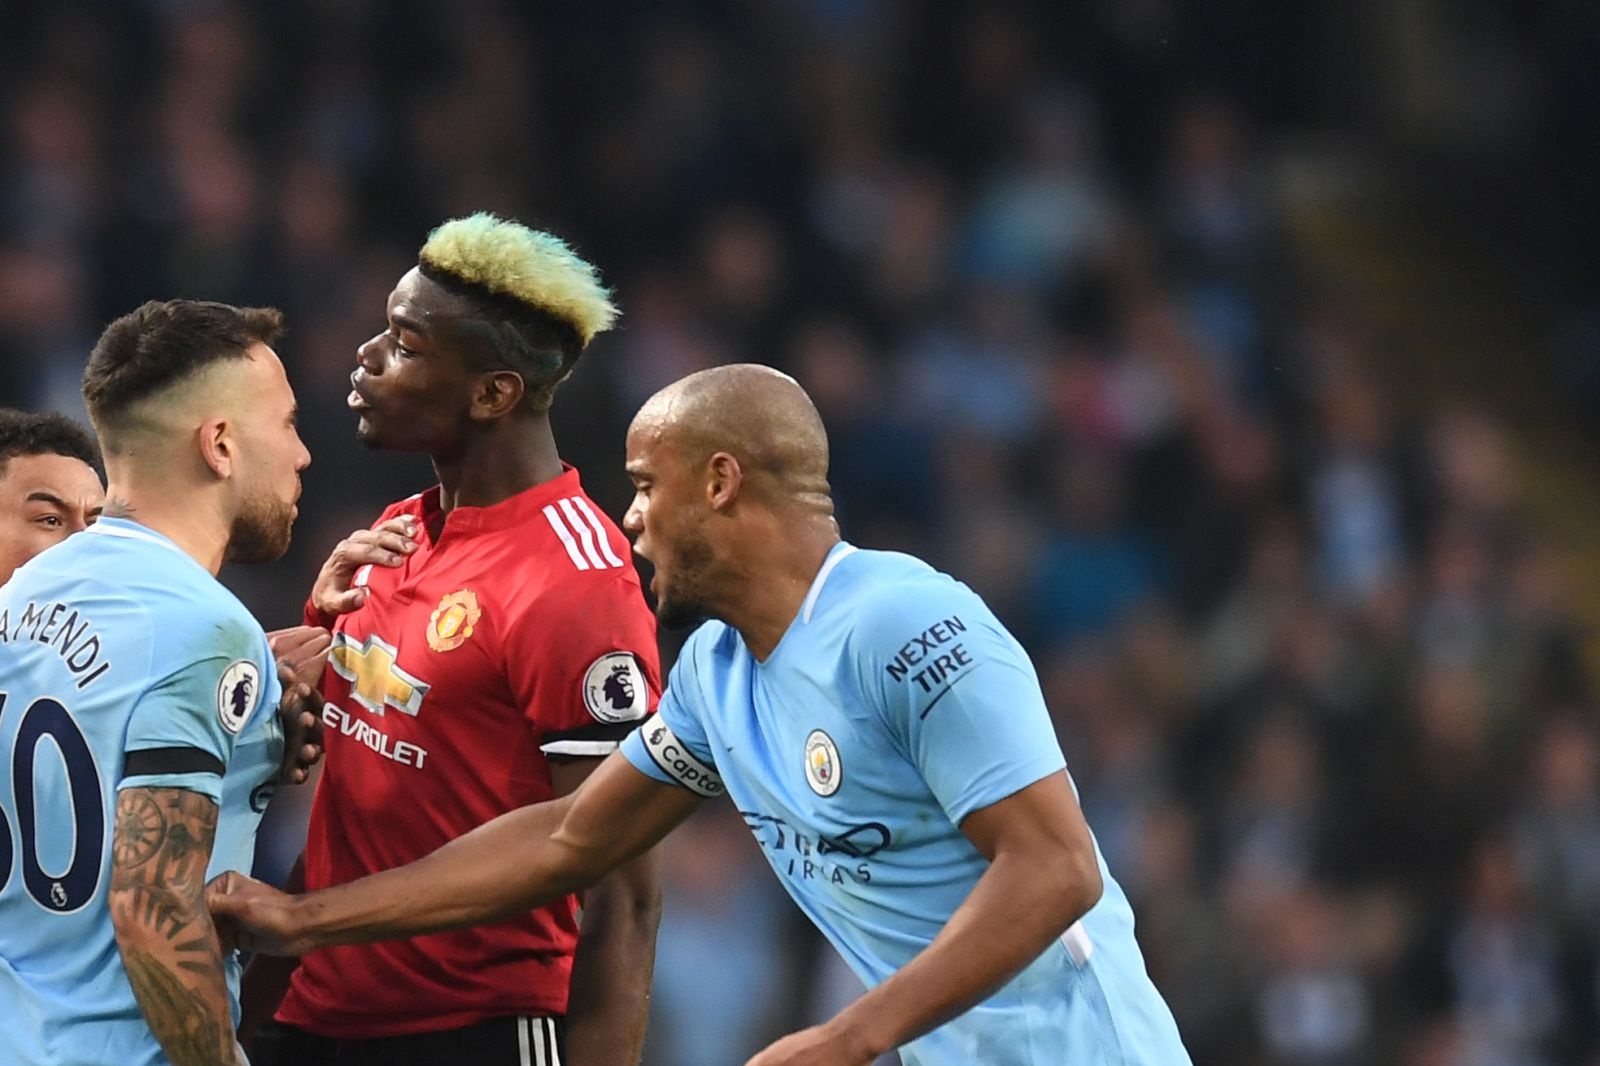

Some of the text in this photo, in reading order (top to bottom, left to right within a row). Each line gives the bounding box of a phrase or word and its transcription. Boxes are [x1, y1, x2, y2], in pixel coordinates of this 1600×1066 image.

[885, 615, 967, 683] NEXEN
[911, 643, 973, 693] TIRE
[322, 702, 428, 769] EVROLET
[662, 745, 722, 793] Capta
